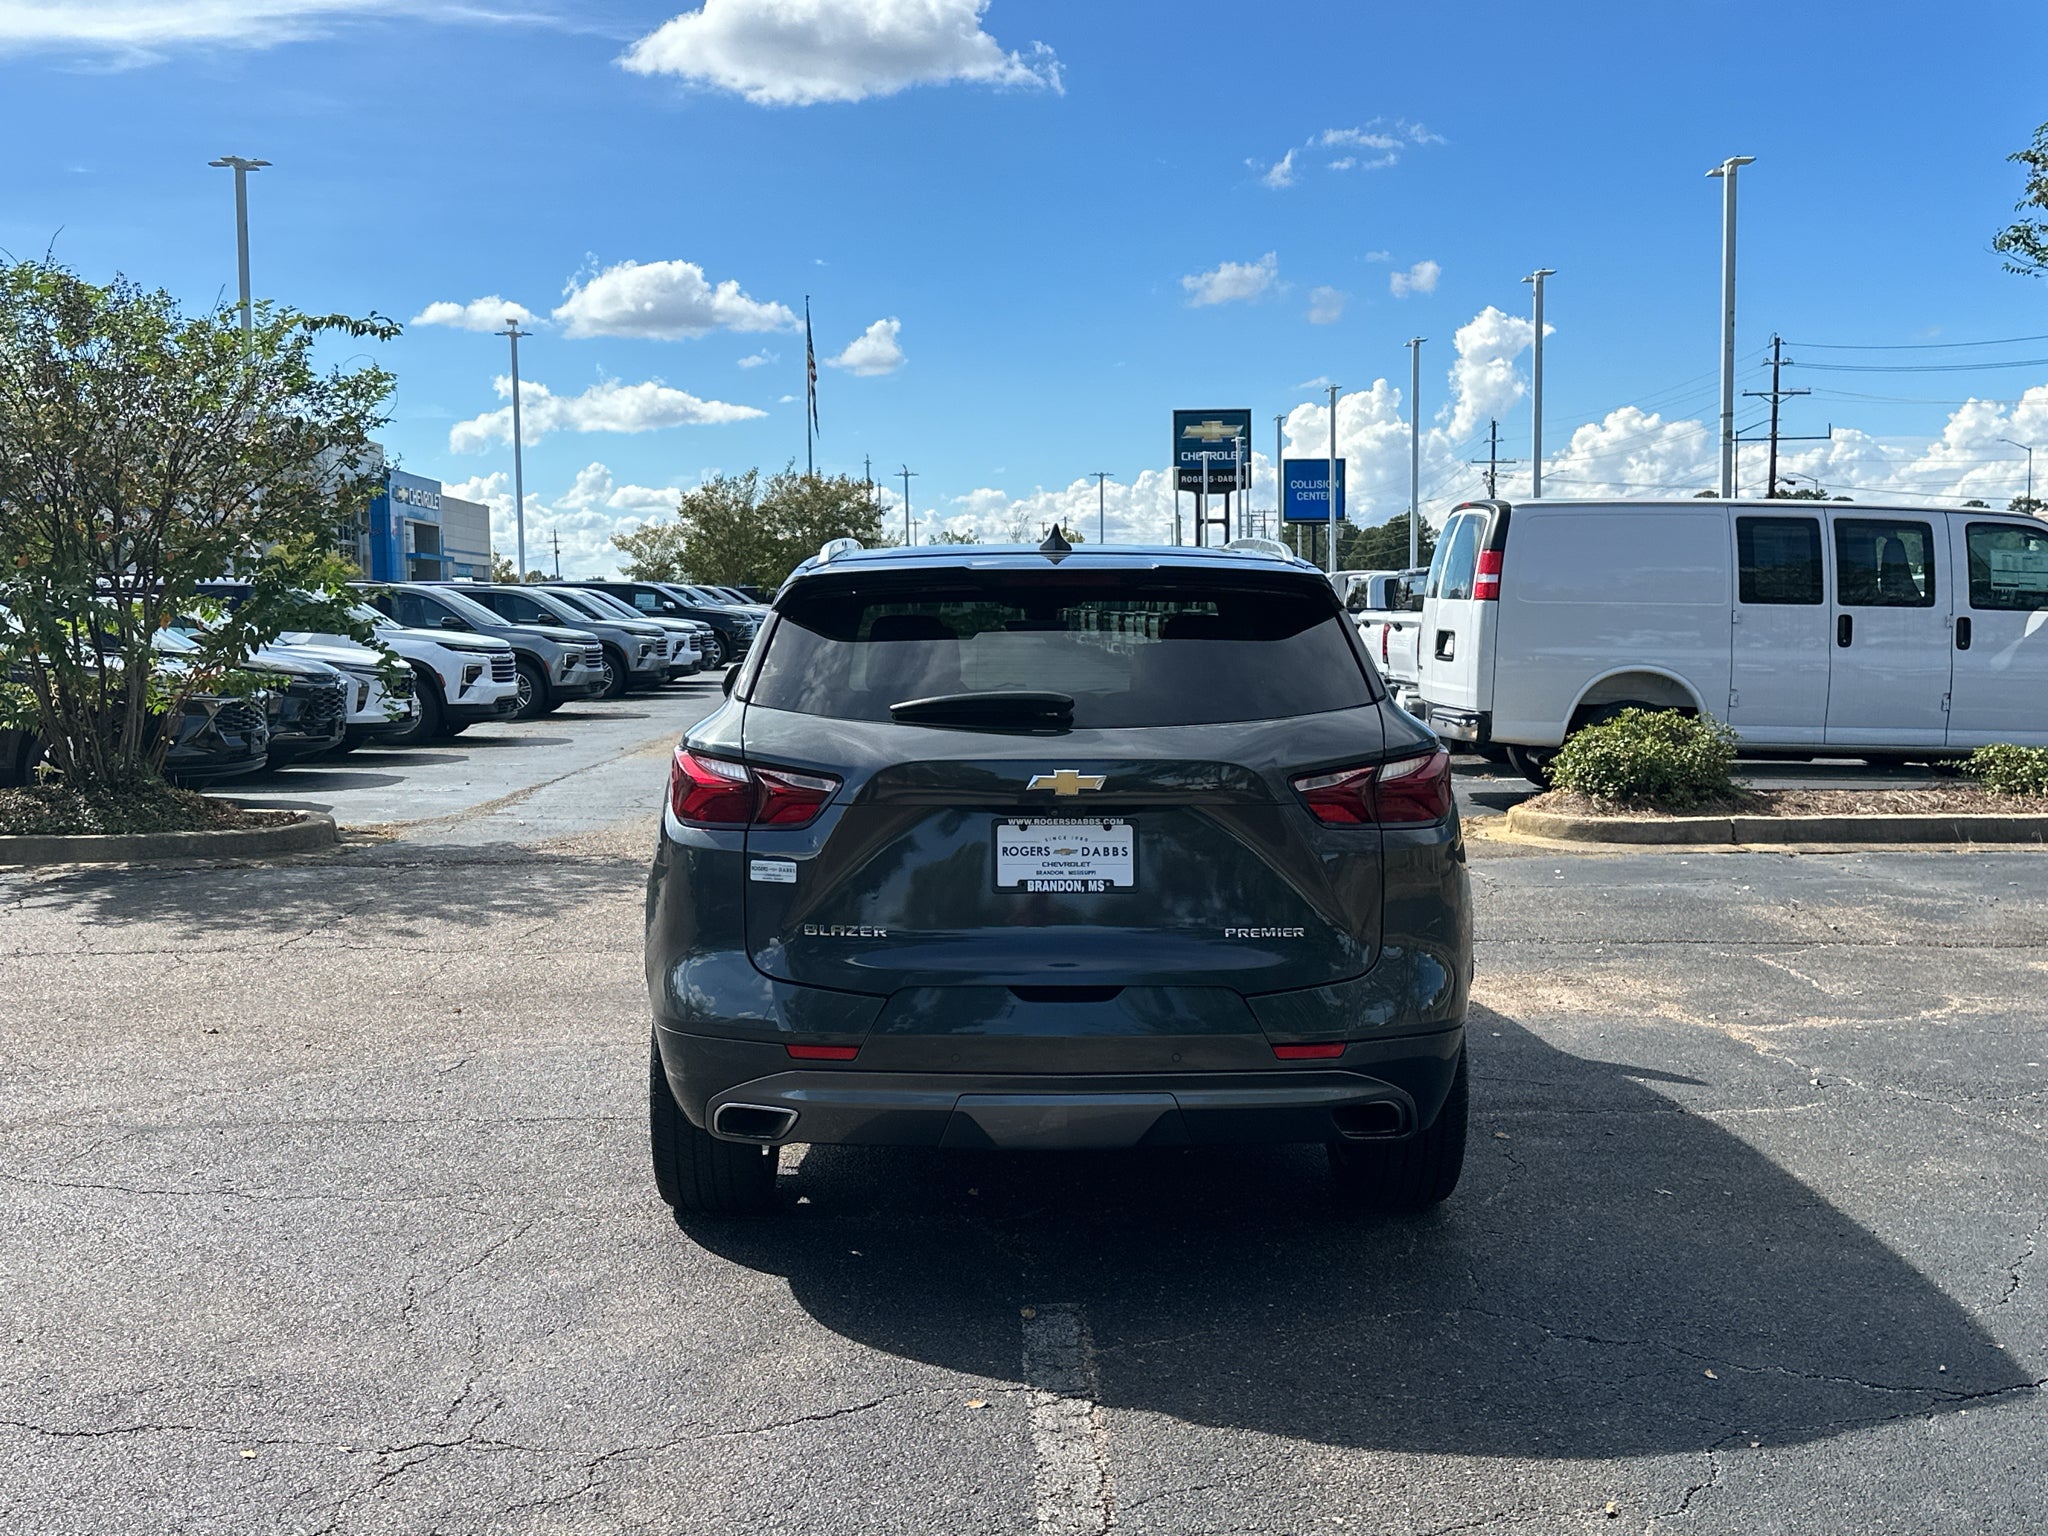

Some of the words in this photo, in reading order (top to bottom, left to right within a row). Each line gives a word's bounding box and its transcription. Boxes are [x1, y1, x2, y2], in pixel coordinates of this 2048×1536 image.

[1181, 475, 1214, 483] ROGES
[409, 487, 441, 510] CHEVROLET
[1008, 818, 1124, 826] WWW.ROGERSDABBS.COM
[1002, 846, 1051, 857] ROGERS
[1081, 846, 1129, 857] DABBS
[1027, 880, 1085, 893] BRANDON,
[1087, 880, 1105, 892] MS
[804, 923, 888, 938] BLAZER
[1224, 927, 1305, 938] PREMIER
